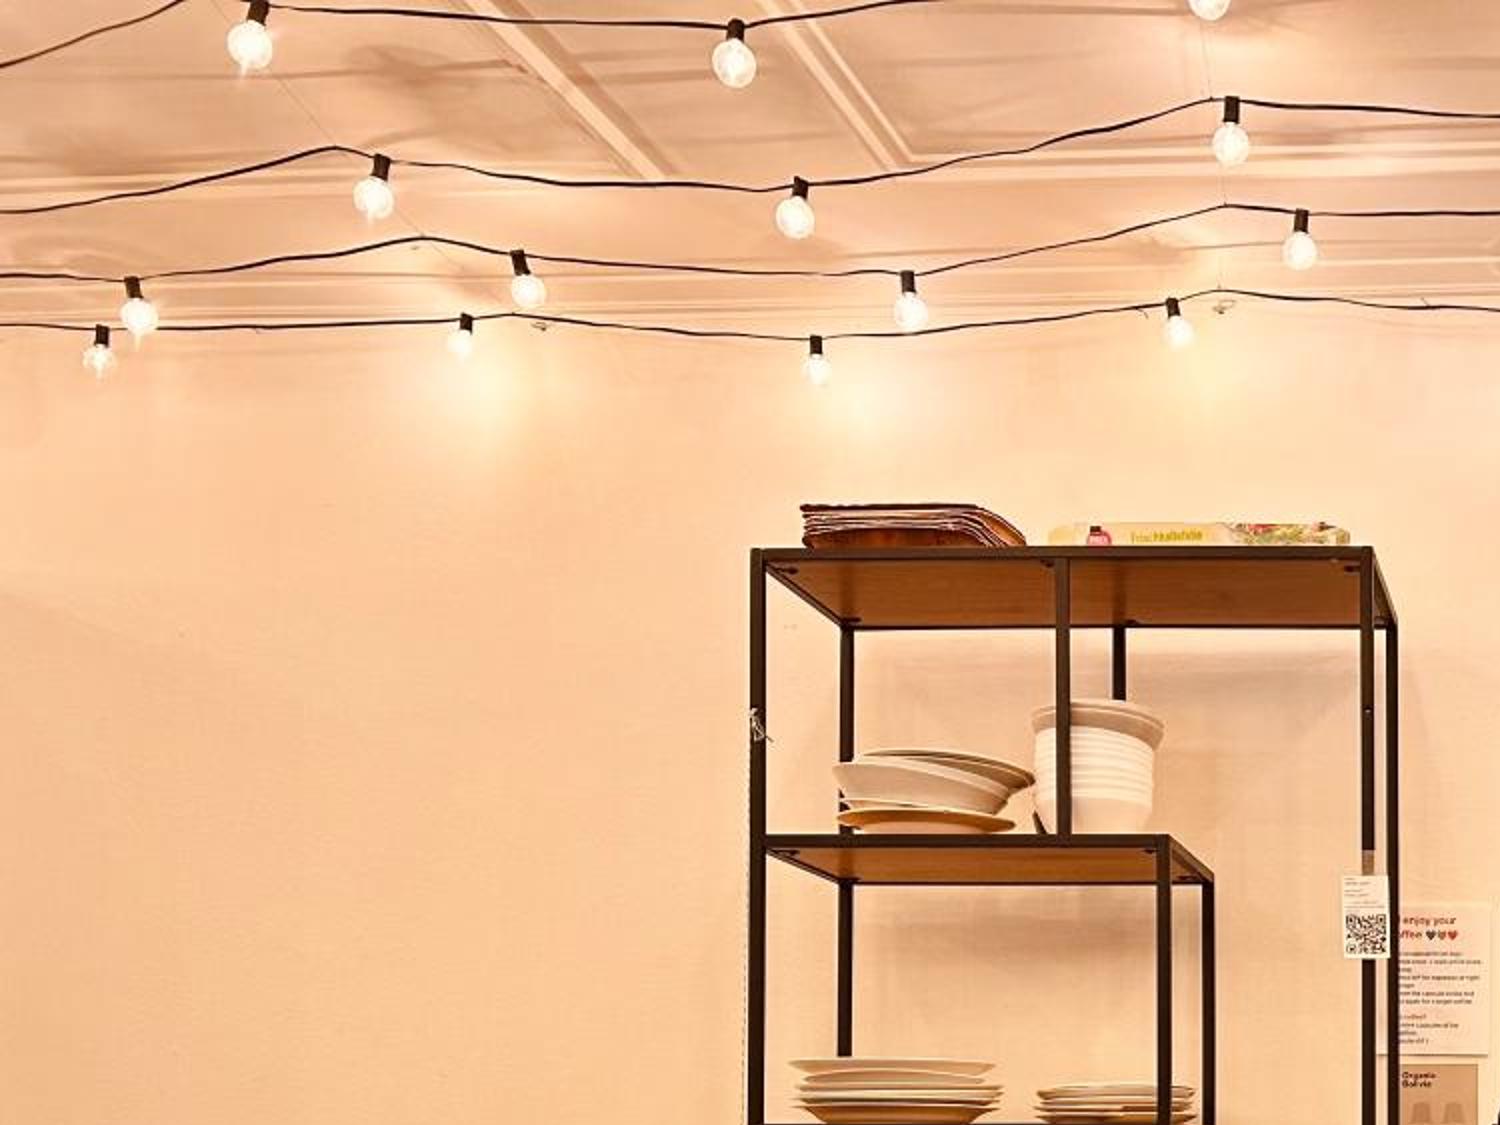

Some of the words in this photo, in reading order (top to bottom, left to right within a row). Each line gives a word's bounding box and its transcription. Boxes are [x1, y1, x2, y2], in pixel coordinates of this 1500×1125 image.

[1403, 916, 1430, 926] enjoy
[1433, 917, 1457, 926] your
[1399, 929, 1422, 939] ffee
